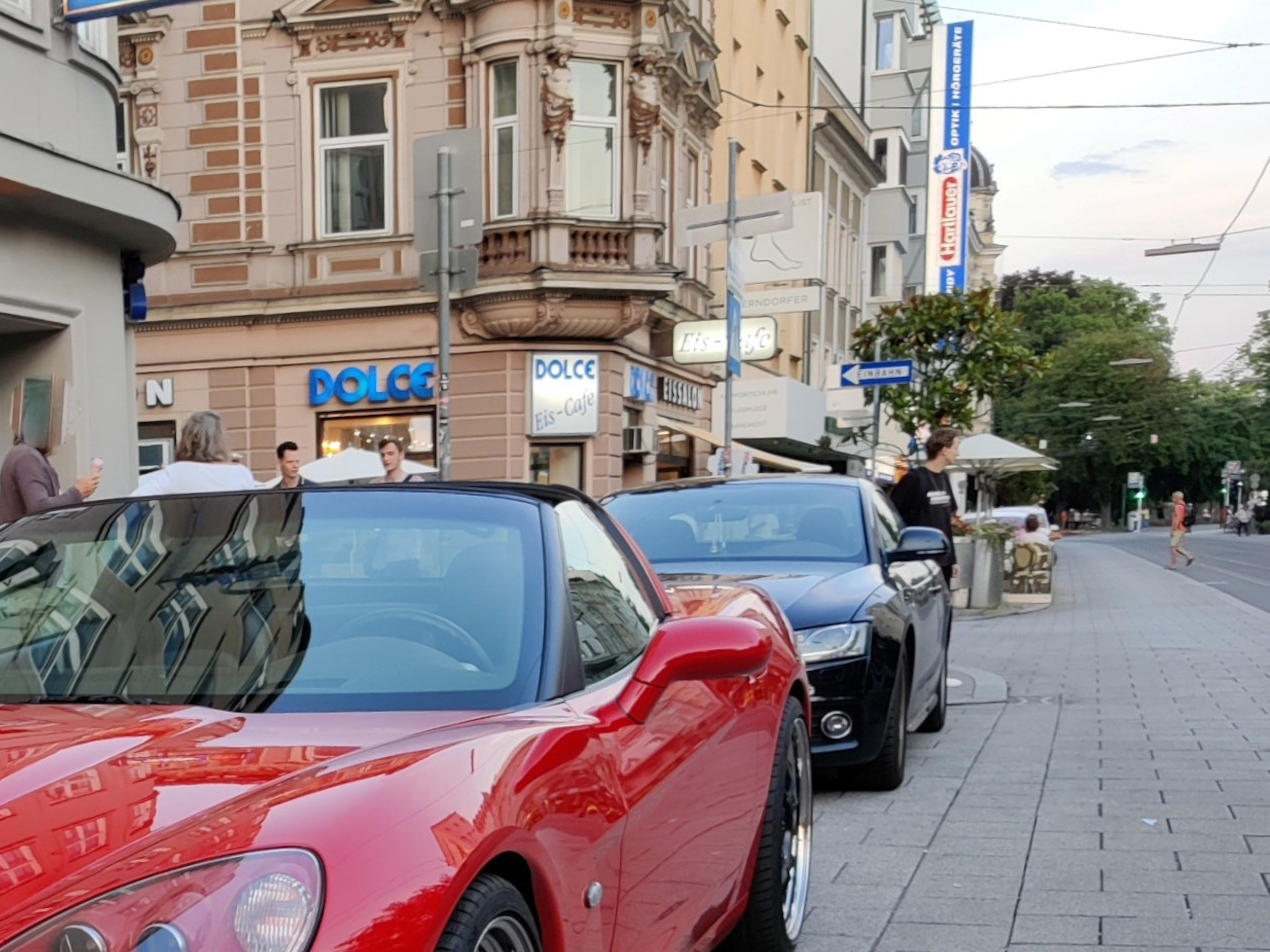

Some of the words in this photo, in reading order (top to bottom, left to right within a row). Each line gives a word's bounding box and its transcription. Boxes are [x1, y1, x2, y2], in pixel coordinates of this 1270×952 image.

[950, 26, 963, 99] HÖRGERÄTE
[950, 109, 960, 147] OPTIK
[940, 182, 958, 256] Hartlauer
[945, 269, 956, 294] NDY
[743, 294, 809, 308] ERNDORFER
[309, 362, 436, 407] DOLCE
[535, 359, 595, 379] DOLCE
[857, 369, 902, 379] EINBAHN
[144, 378, 174, 408] N
[663, 376, 703, 411] EISSALON
